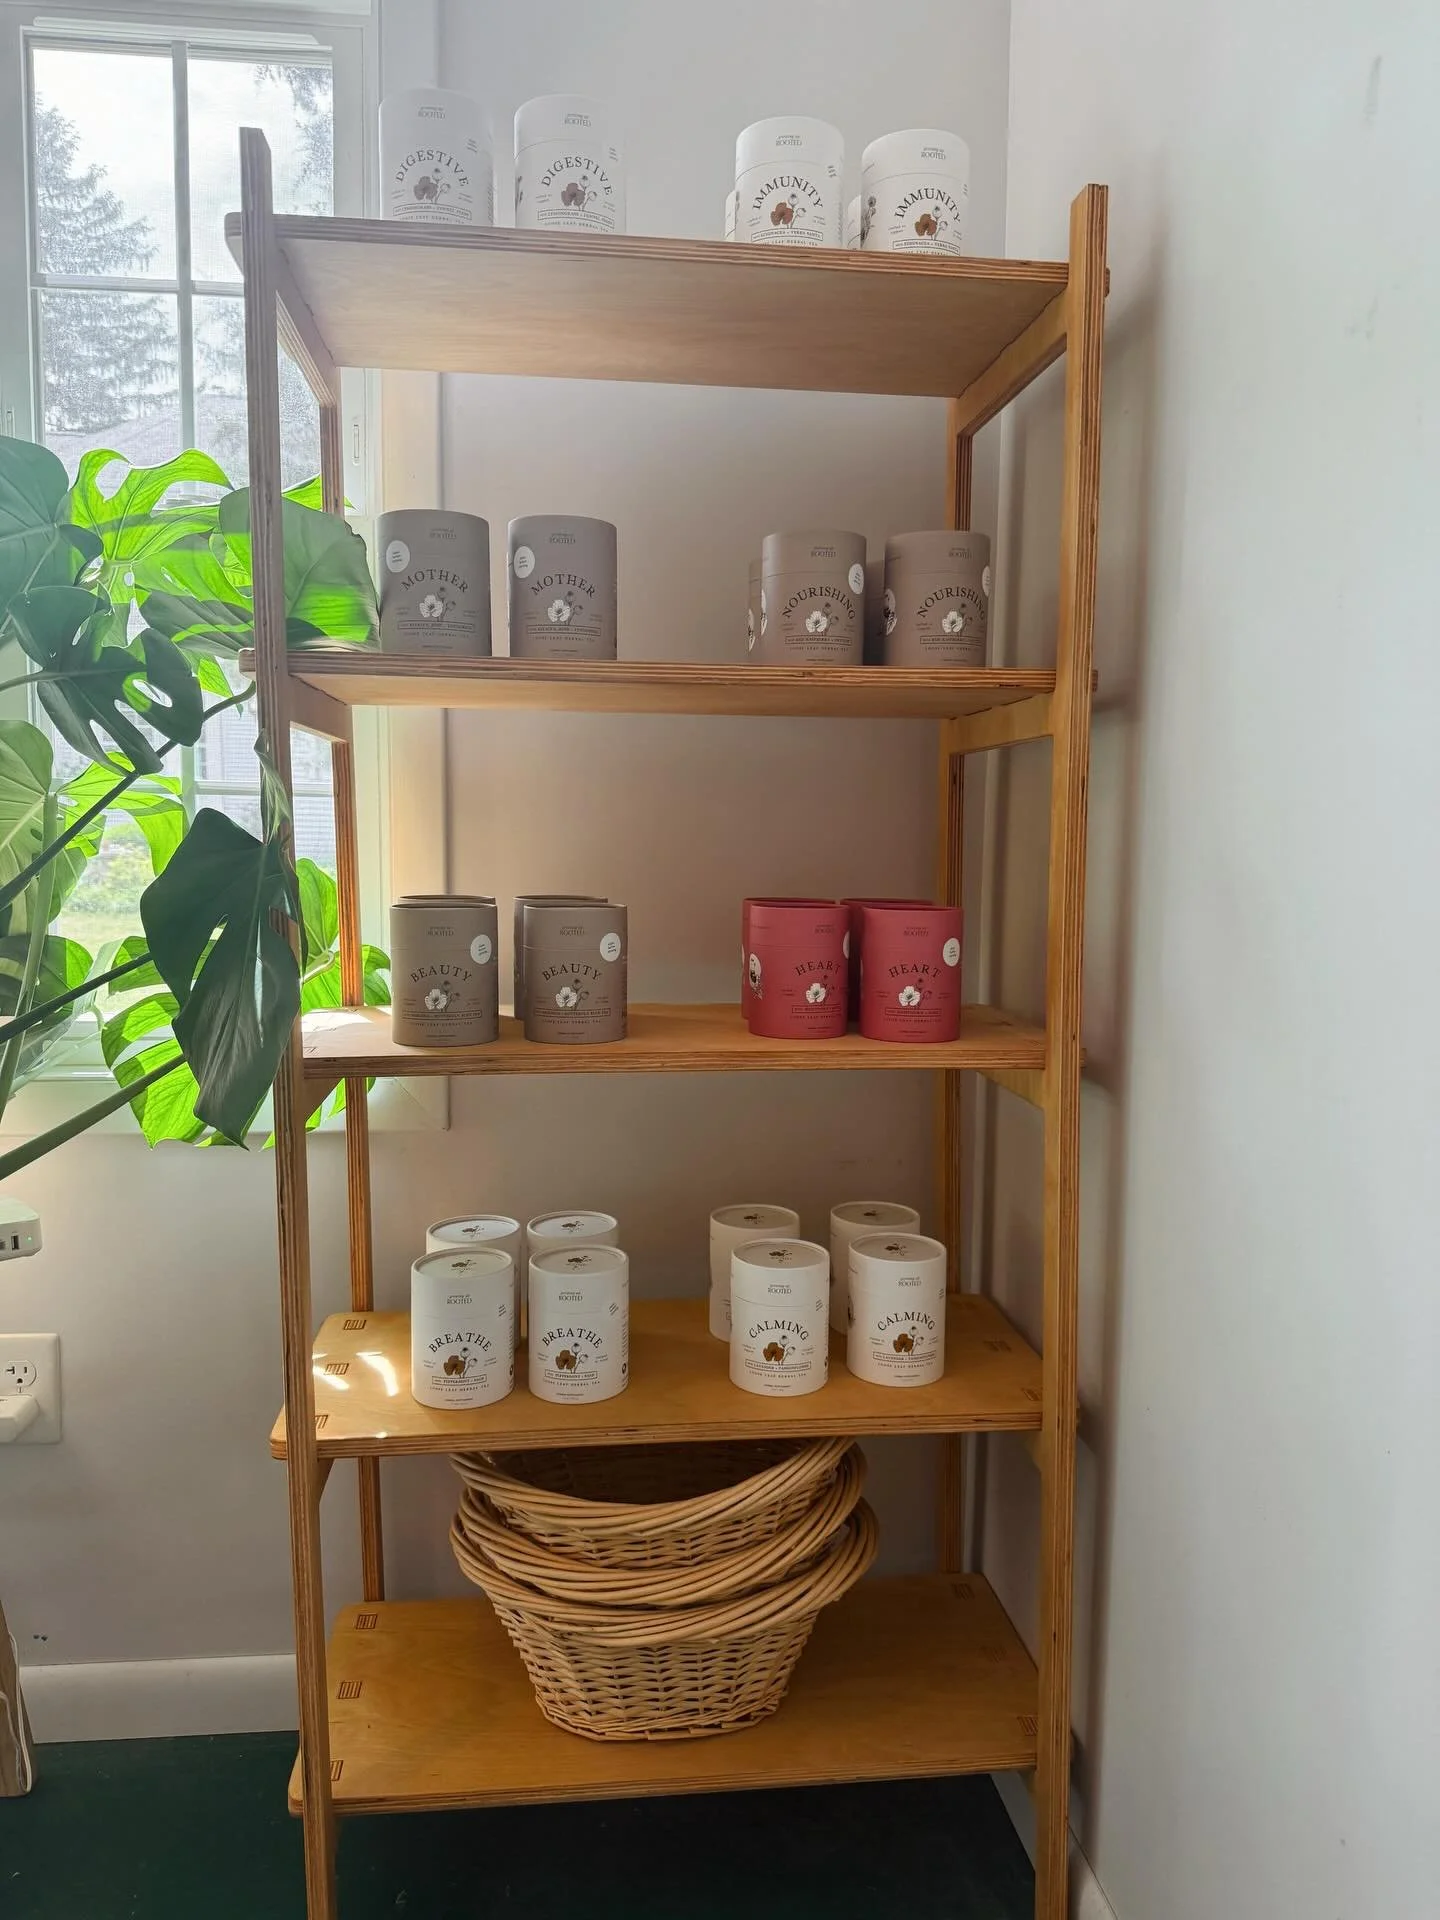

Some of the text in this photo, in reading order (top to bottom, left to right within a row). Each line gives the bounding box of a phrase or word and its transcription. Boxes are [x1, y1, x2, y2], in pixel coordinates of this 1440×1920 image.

[395, 149, 469, 187] DIGESTIVE
[541, 156, 613, 195] DIGESTIVE
[752, 175, 824, 209] IMMUNITY
[894, 187, 961, 224] IMMUNITY
[400, 569, 469, 593] MOTHER
[531, 573, 596, 599] MOTHER
[781, 586, 856, 620] NOURISHING
[410, 964, 472, 983] BEAUTY
[542, 963, 602, 981] BEAUTY
[795, 961, 841, 977] HEART
[888, 963, 941, 978] HEART
[749, 1320, 809, 1341] CALMING
[877, 1311, 935, 1331] CALMING
[428, 1331, 492, 1353] BREATHE
[542, 1328, 603, 1349] BREATHE
